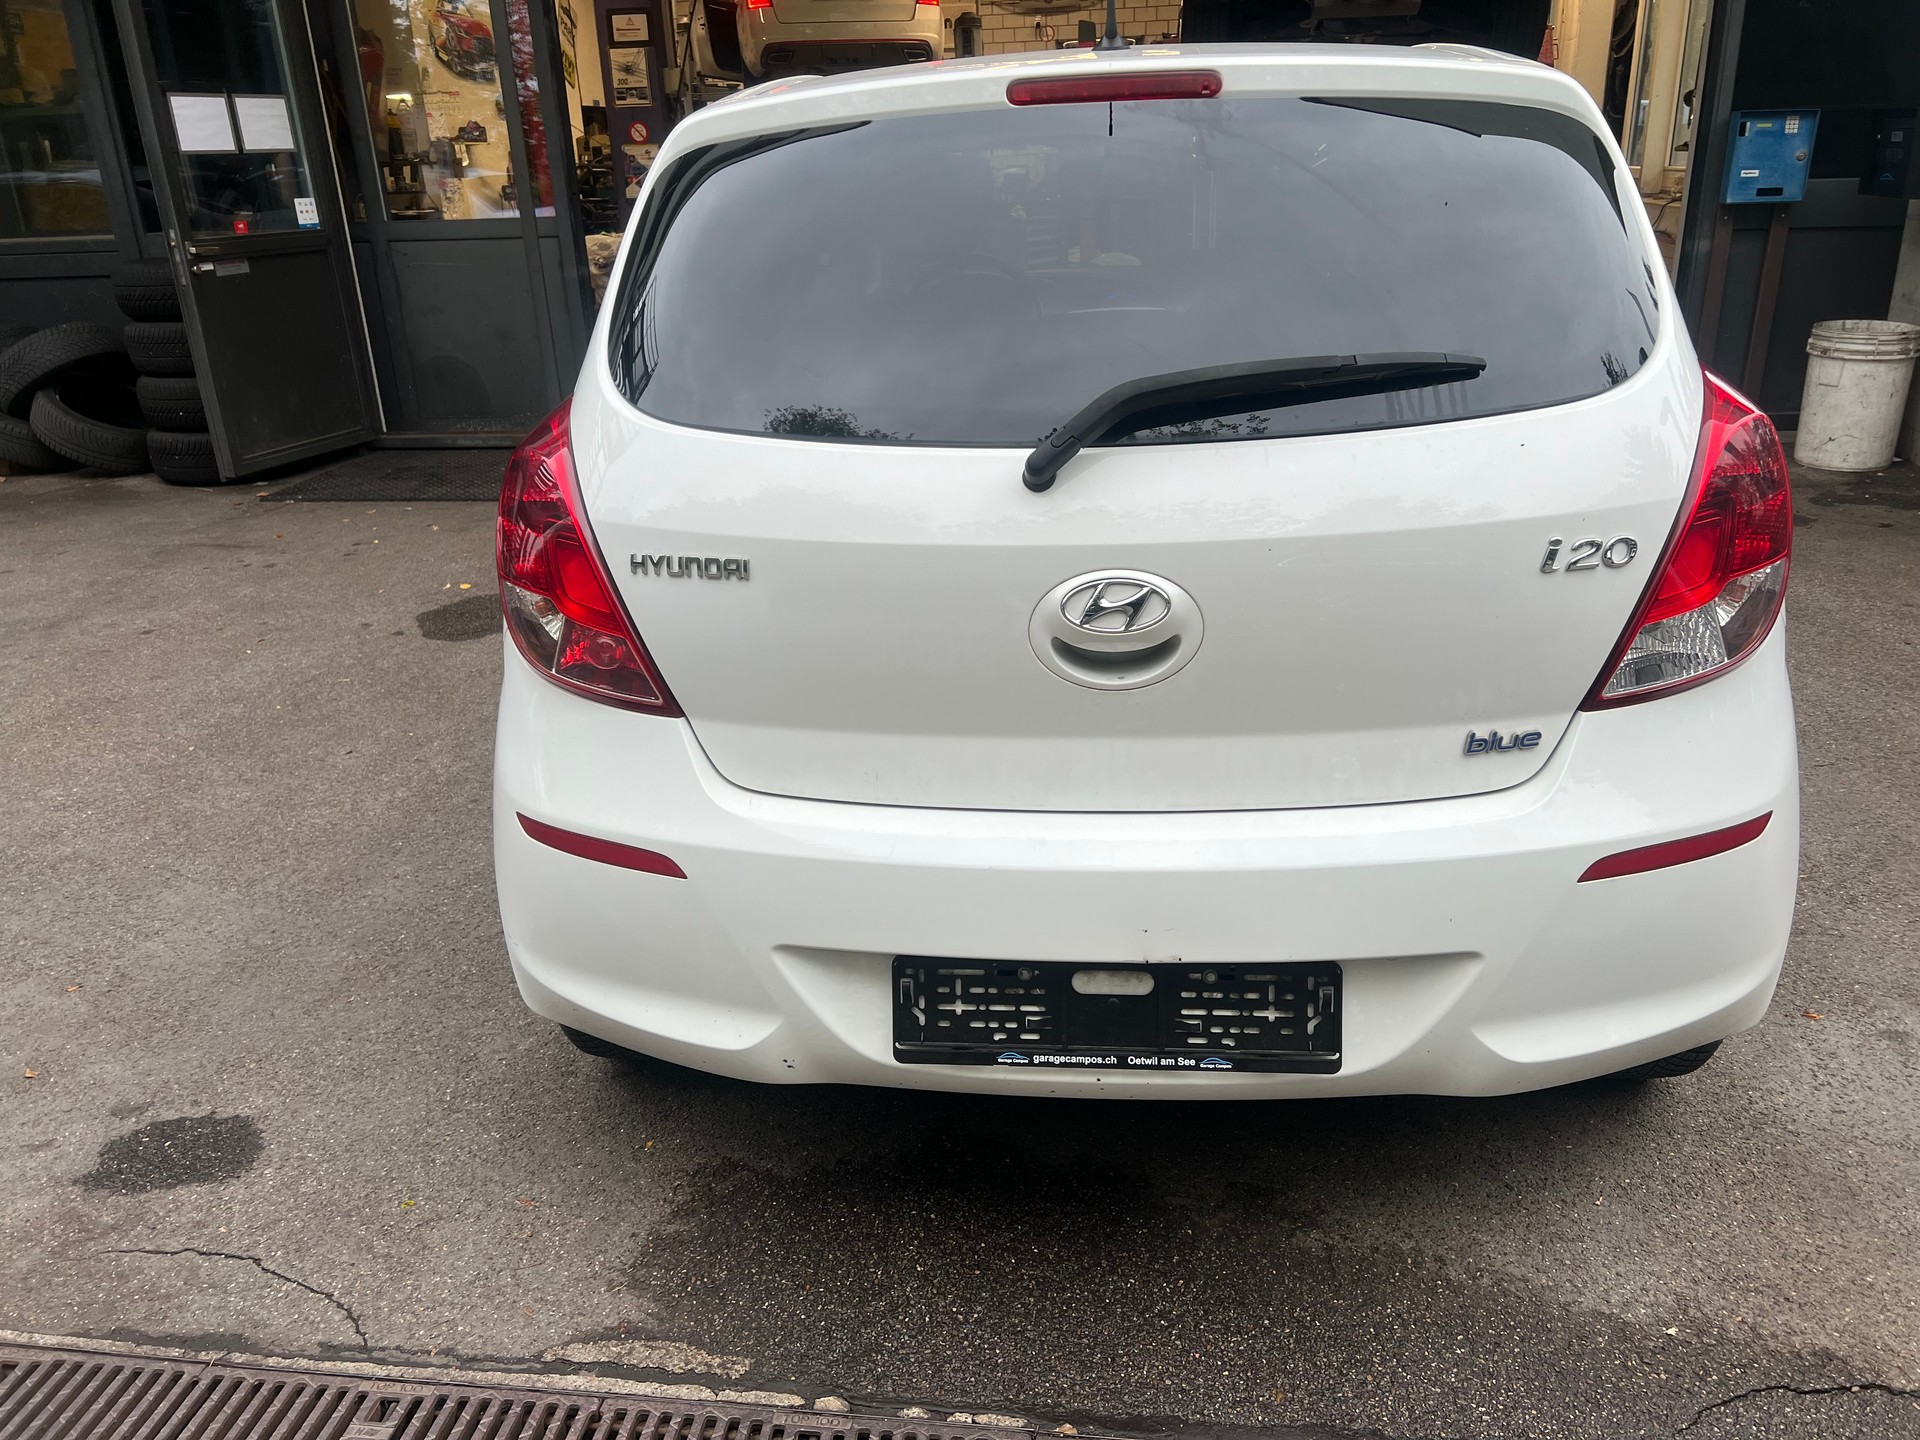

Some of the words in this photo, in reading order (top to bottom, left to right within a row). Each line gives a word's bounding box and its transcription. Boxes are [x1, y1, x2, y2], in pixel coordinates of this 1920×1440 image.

[1540, 535, 1638, 573] i20
[630, 553, 750, 581] HYUNDAI
[1463, 729, 1543, 756] blue
[1033, 1055, 1117, 1065] garagecampos.ch
[1127, 1056, 1158, 1065] Oetwil
[1160, 1058, 1175, 1066] am
[1177, 1057, 1196, 1066] See
[370, 1382, 396, 1391] TOP
[400, 1384, 424, 1393] 100
[784, 1413, 810, 1424] TOP
[816, 1416, 841, 1427] 100
